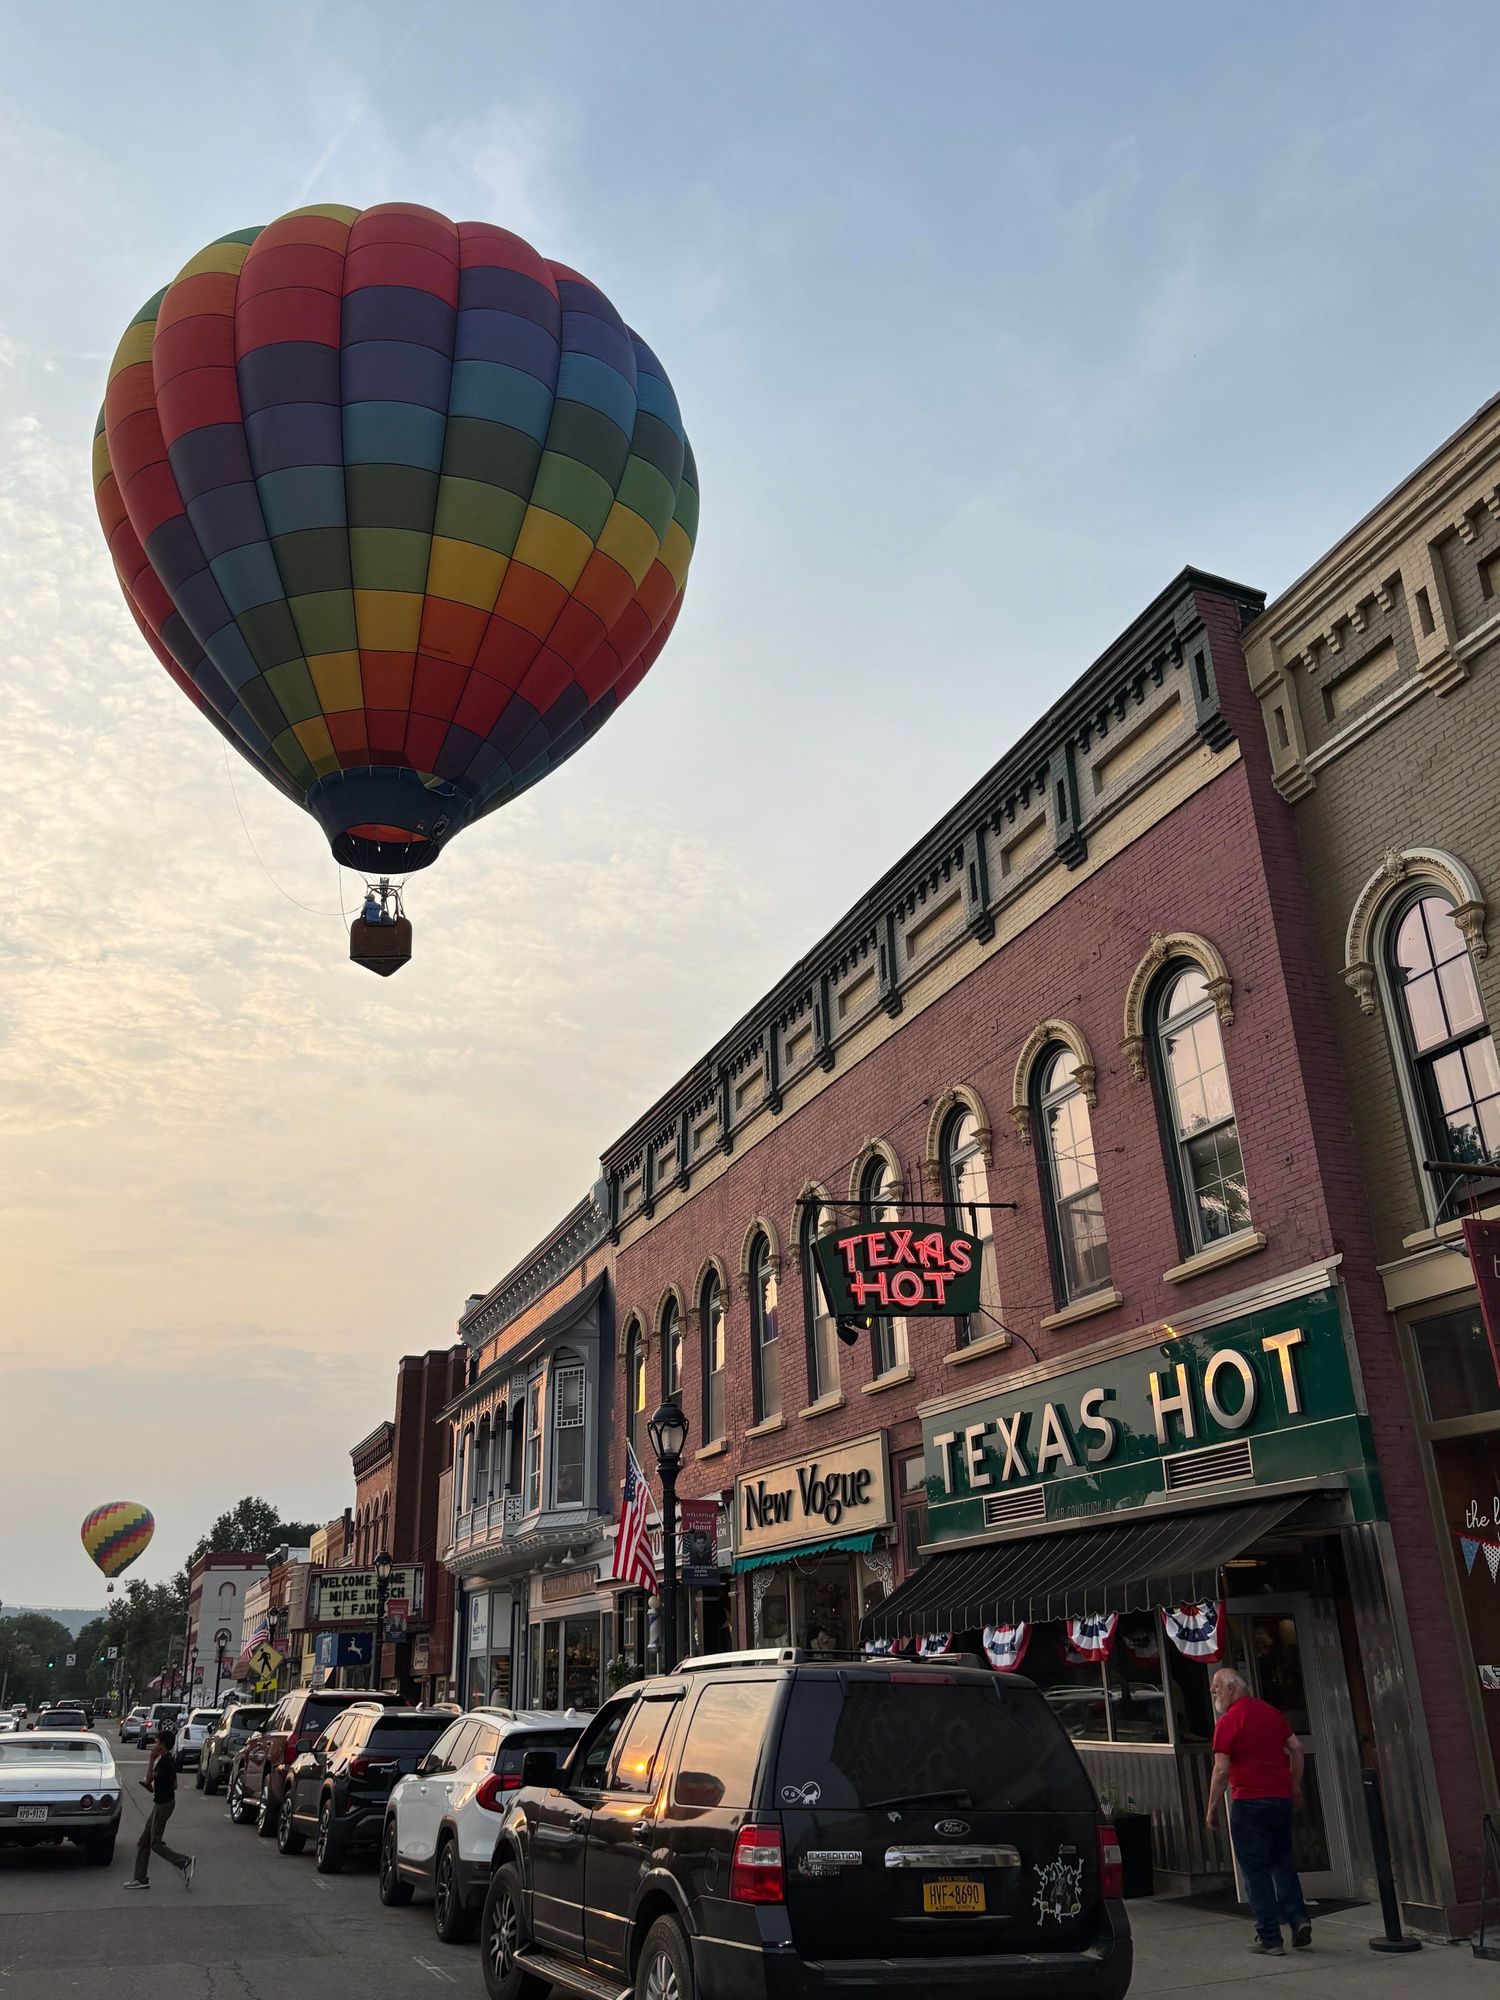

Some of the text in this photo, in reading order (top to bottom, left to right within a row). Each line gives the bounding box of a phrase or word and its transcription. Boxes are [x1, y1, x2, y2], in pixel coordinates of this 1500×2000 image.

[838, 1229, 972, 1273] TEXAS
[850, 1270, 956, 1308] HOT
[932, 1327, 1305, 1494] TEXAS HOT
[743, 1463, 871, 1531] New Vogue
[1465, 1499, 1490, 1529] the
[689, 1522, 712, 1531] Honor
[320, 1574, 372, 1589] WELCOME
[329, 1586, 405, 1602] MIKE HISCH
[351, 1602, 382, 1616] FAM
[944, 1821, 963, 1833] Ford
[808, 1852, 862, 1861] EXPEDITION
